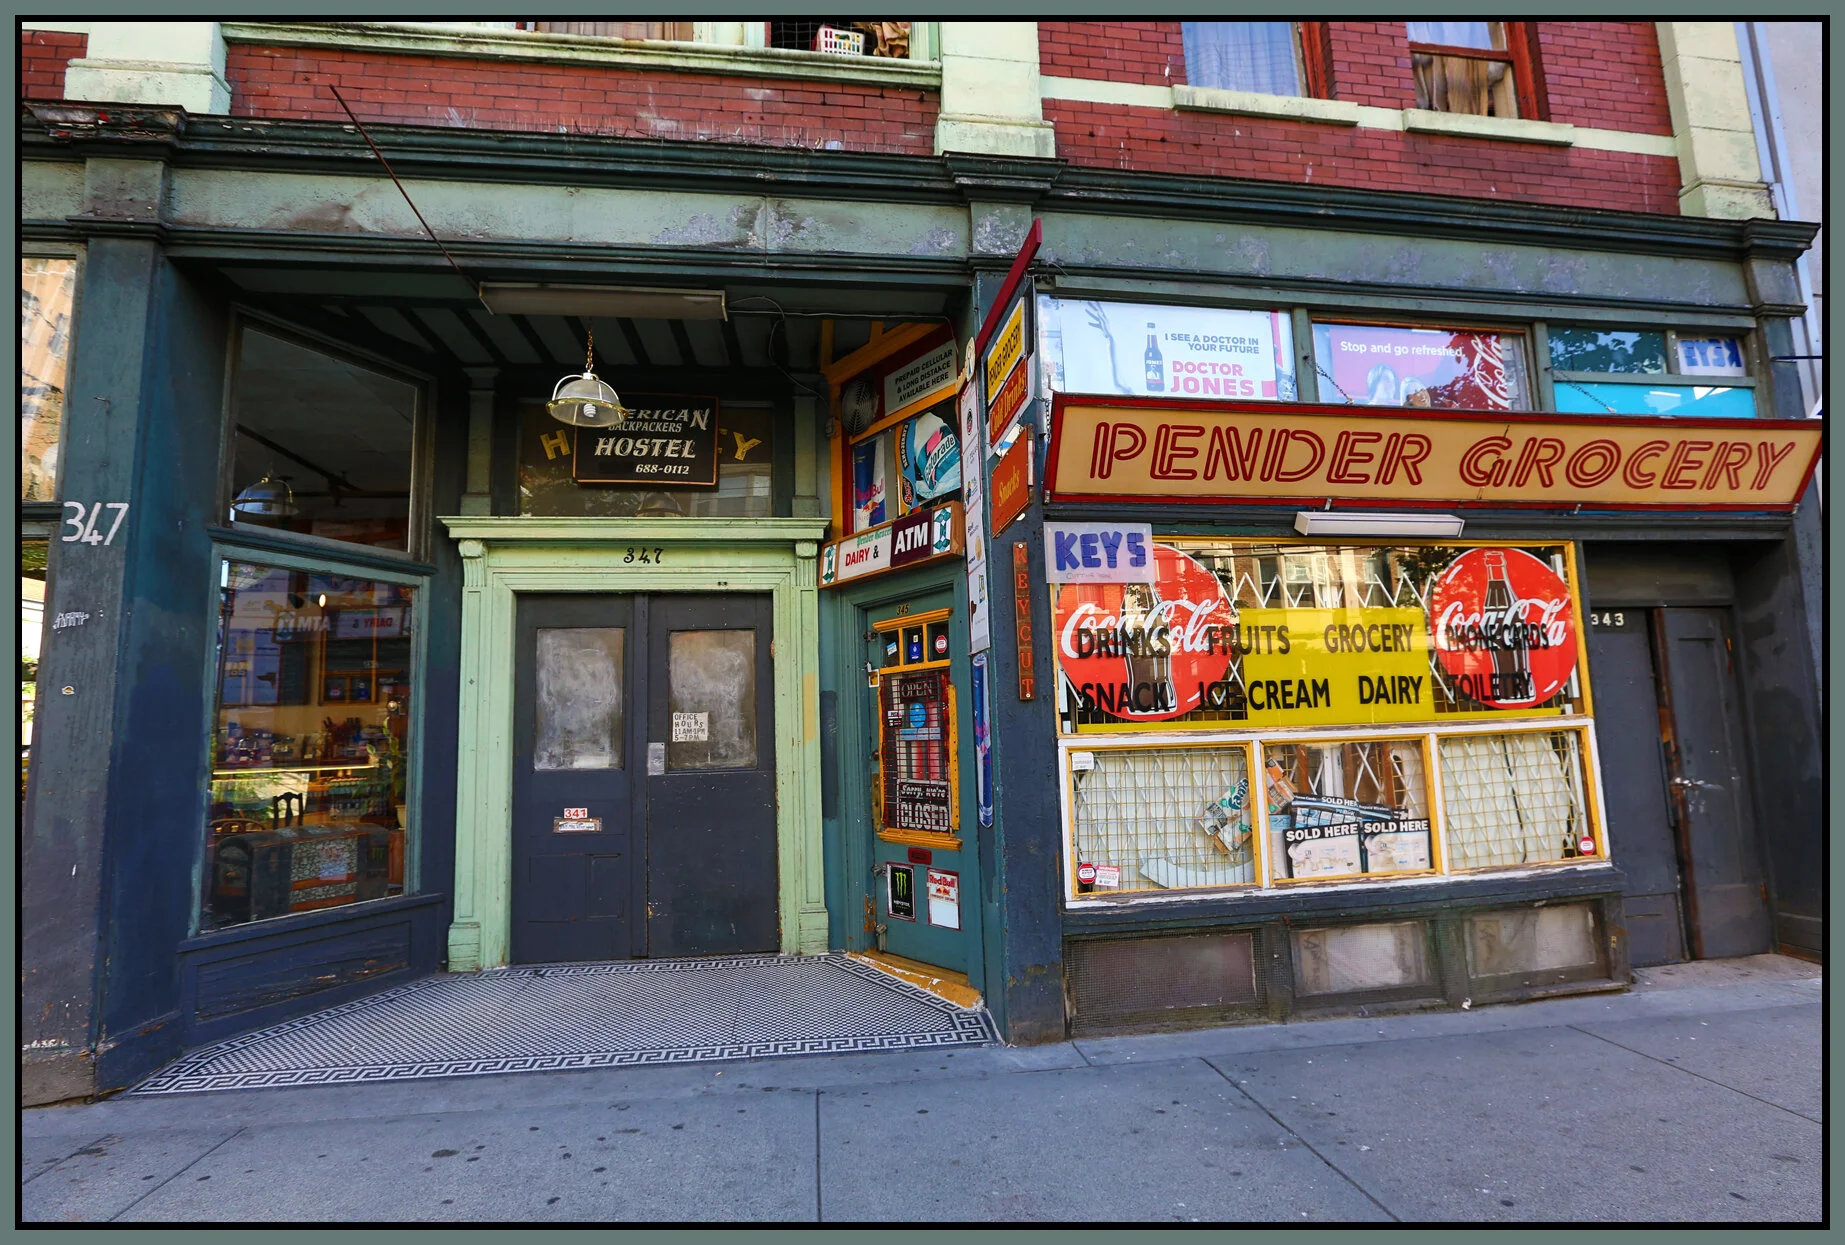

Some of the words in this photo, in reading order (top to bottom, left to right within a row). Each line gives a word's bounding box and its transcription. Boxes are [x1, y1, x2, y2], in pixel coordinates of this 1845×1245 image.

[1165, 333, 1168, 341] I
[1171, 333, 1190, 342] SEE
[1193, 335, 1202, 343] A
[1203, 335, 1246, 345] DOCTOR
[1249, 337, 1259, 346] IN
[1188, 343, 1217, 352] YOUR
[1219, 343, 1260, 354] FUTURE
[1340, 341, 1367, 354] Stop
[1370, 341, 1391, 354] and
[1394, 344, 1409, 356] go
[1411, 345, 1466, 358] refreshed.
[895, 367, 920, 385] PREPAID
[921, 349, 953, 371] CELLULAR
[903, 377, 919, 391] LONG
[921, 360, 952, 382] DISTANCE
[1172, 360, 1243, 377] DOCTOR
[899, 381, 930, 403] AVAILABLE
[931, 371, 949, 386] HERE
[1170, 375, 1255, 397] JONES
[628, 408, 710, 430] ERICAN
[594, 437, 696, 459] HOSTEL
[1089, 421, 1432, 486] PENDER
[1459, 435, 1796, 491] GROCERY
[635, 463, 690, 475] 688-0112
[999, 465, 1020, 508] Snacks
[61, 501, 130, 545] 347
[845, 547, 870, 566] DAIRY
[873, 545, 879, 559] &
[894, 522, 929, 555] ATM
[1055, 531, 1146, 571] KEYS
[623, 547, 664, 564] 347
[897, 603, 911, 616] 345
[1591, 613, 1624, 627] 343
[1061, 598, 1220, 658] Coca-Cola
[1436, 598, 1569, 651] Coca-Cola
[1077, 628, 1171, 659] DRINKS
[1207, 625, 1291, 655] FRUITS
[1324, 624, 1414, 653] GROCERY
[1445, 624, 1498, 651] PHONE
[1501, 623, 1549, 650] CARDS
[901, 681, 933, 697] OPEN
[1081, 682, 1170, 713] SNACK
[1198, 681, 1247, 712] ICE
[1248, 678, 1331, 710] CREAM
[1358, 676, 1423, 704] DAIRY
[1448, 672, 1531, 701] TOILETRY
[675, 720, 704, 728] HOURS
[901, 785, 923, 798] Sorry,
[926, 787, 946, 798] we're
[1321, 796, 1342, 805] SOLD
[1344, 799, 1359, 807] HER
[901, 802, 949, 831] CLOSED
[1364, 821, 1396, 833] SOLD
[1400, 820, 1429, 832] HERE
[1286, 828, 1321, 842] SOLD
[1324, 823, 1358, 838] HERE
[929, 875, 941, 884] Red
[941, 876, 956, 888] Bull
